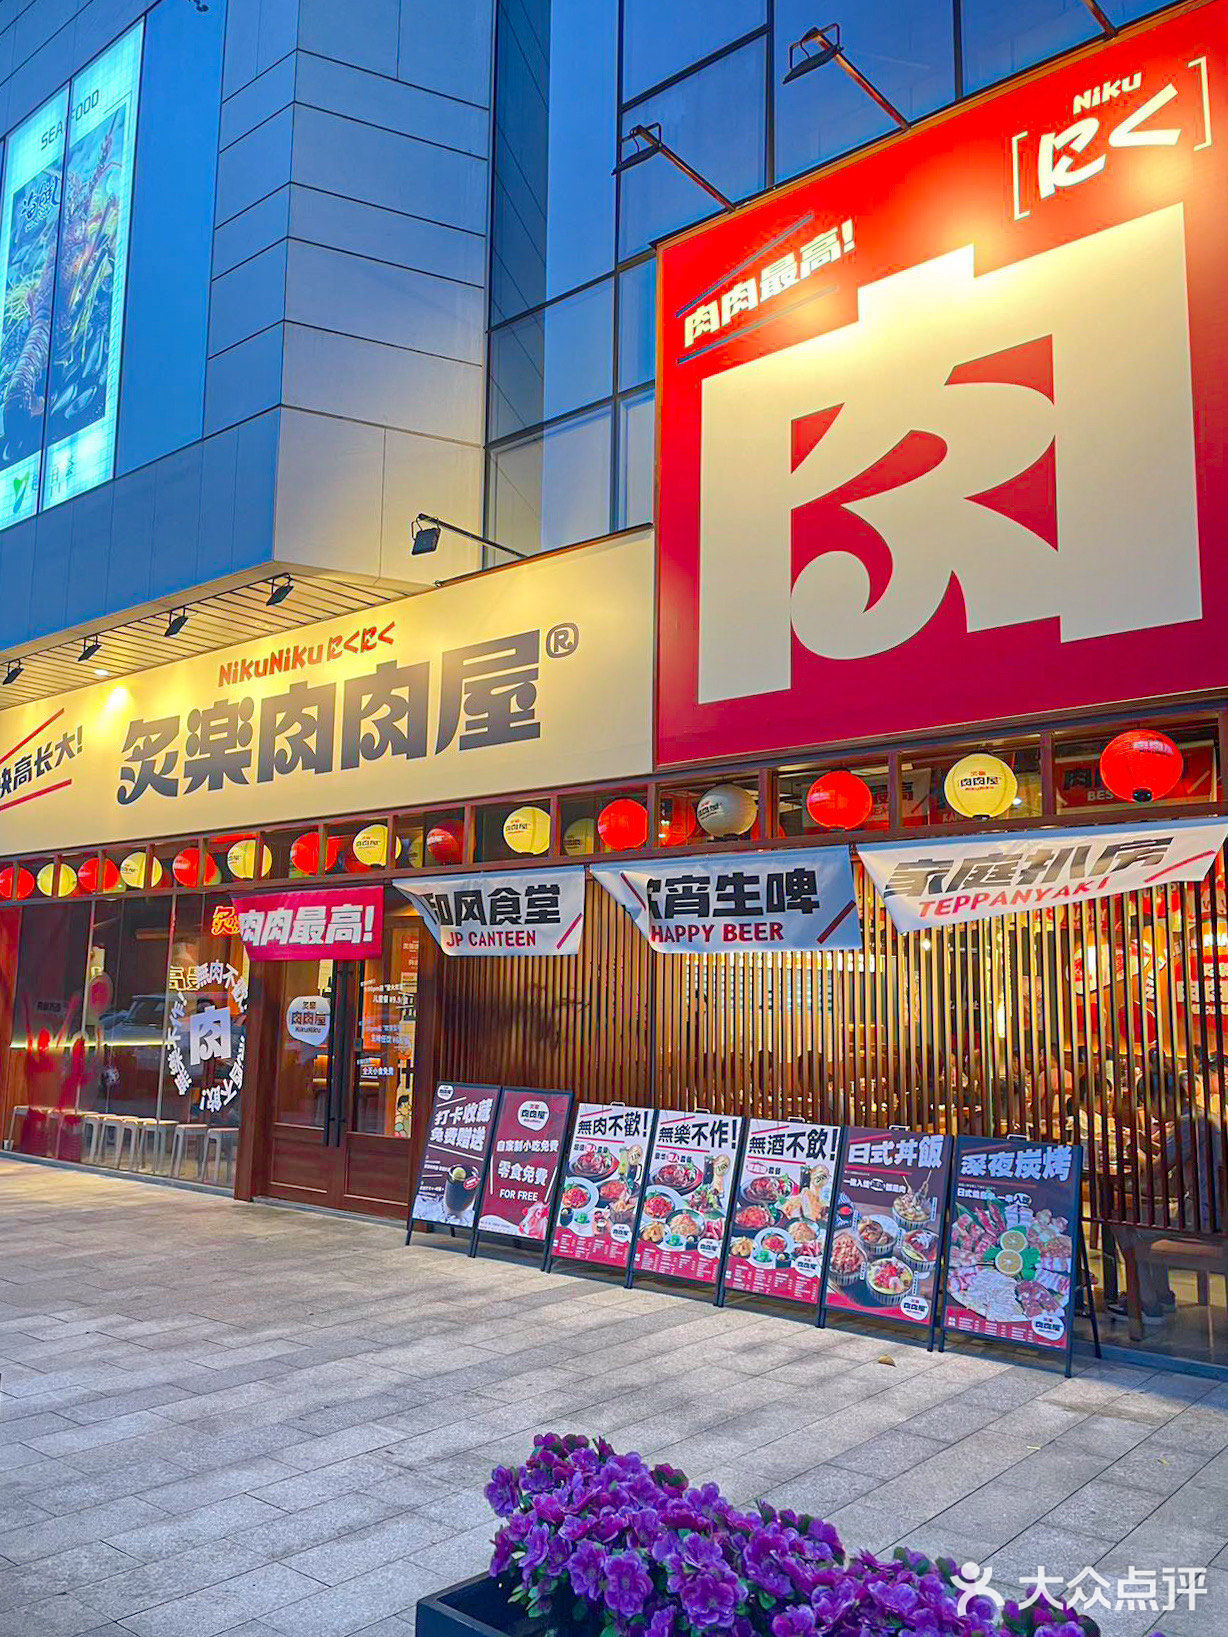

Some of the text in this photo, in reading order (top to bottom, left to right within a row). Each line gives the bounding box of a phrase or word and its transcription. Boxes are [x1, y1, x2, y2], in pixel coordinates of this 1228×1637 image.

[1073, 72, 1142, 115] Niku
[41, 120, 64, 151] SEA
[1037, 83, 1183, 199] にく
[684, 218, 856, 348] 肉肉最高!
[698, 201, 1204, 704] 肉
[883, 837, 1174, 899] 家庭扒房
[919, 876, 1111, 918] TEPPANYAKI
[238, 903, 375, 947] 肉肉最高!
[446, 930, 536, 947] JP CANTEEN
[650, 922, 784, 943] HAPPY BEER
[748, 1128, 839, 1161] 無酒不飲!
[848, 1134, 945, 1169] 日式丼飯
[499, 1189, 539, 1202] FOR FREE
